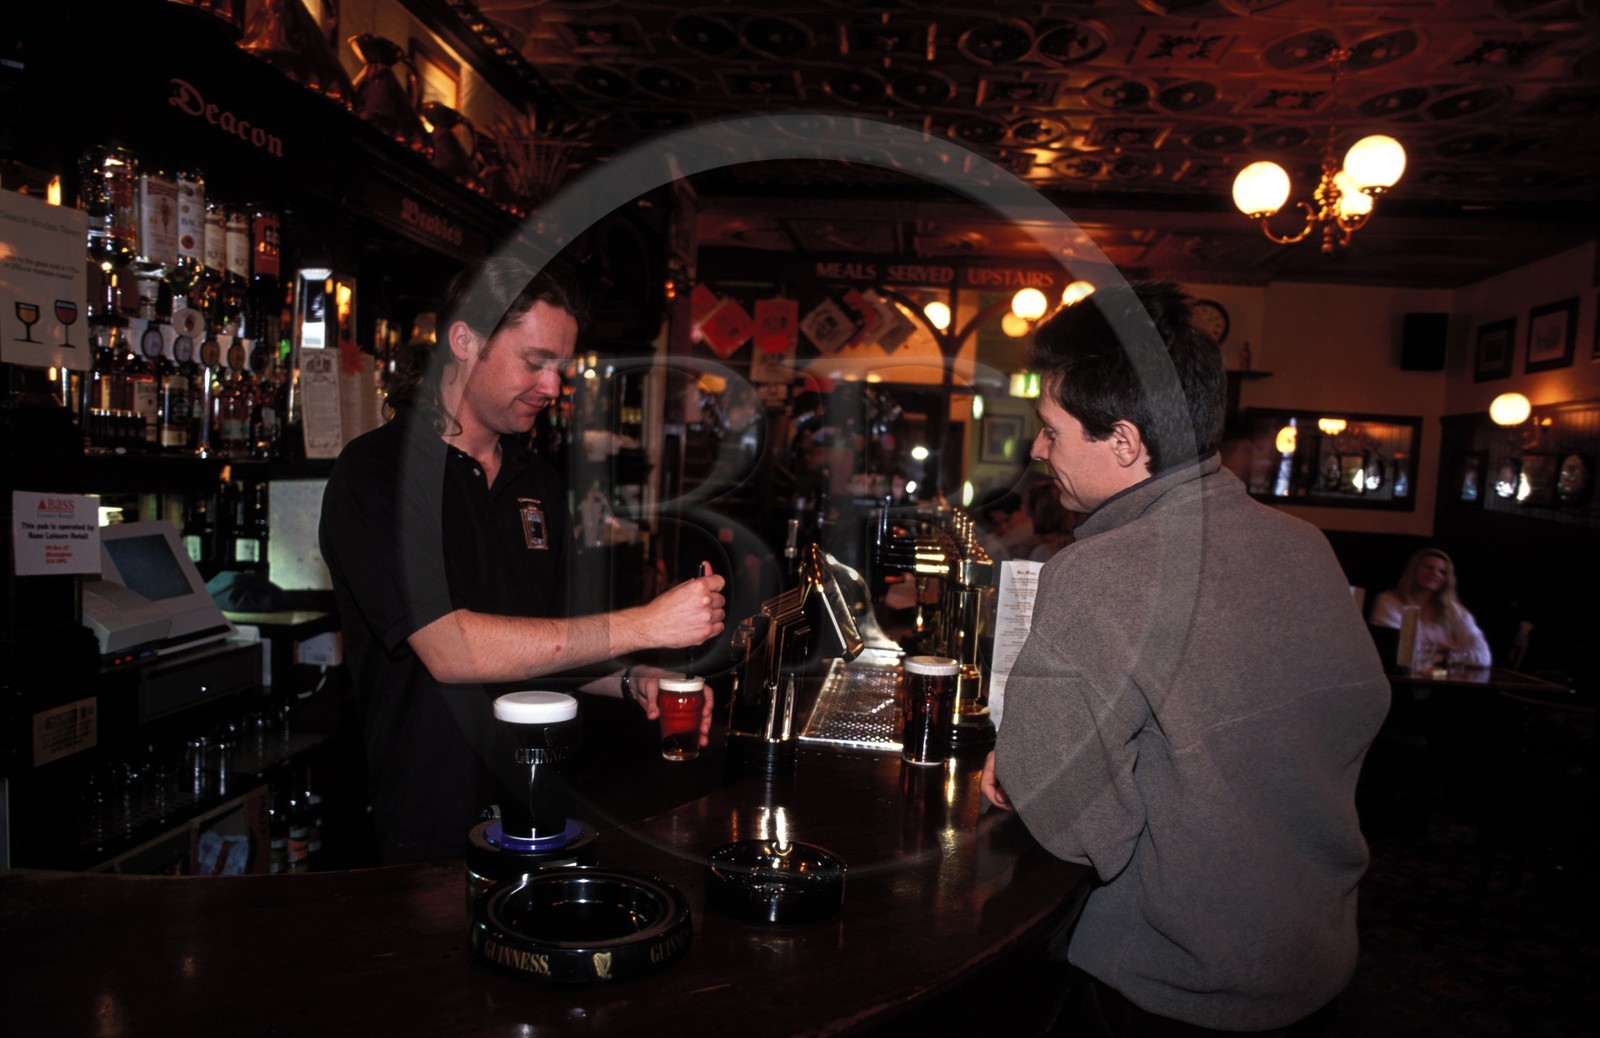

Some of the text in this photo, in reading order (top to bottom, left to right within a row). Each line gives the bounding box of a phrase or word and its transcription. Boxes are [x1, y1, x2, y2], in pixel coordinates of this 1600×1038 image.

[167, 77, 284, 158] Deacon
[816, 262, 1054, 287] MEALS SERVED UPSTAIRS
[58, 523, 85, 531] operated
[87, 524, 94, 532] by
[484, 938, 549, 975] GUINNESS
